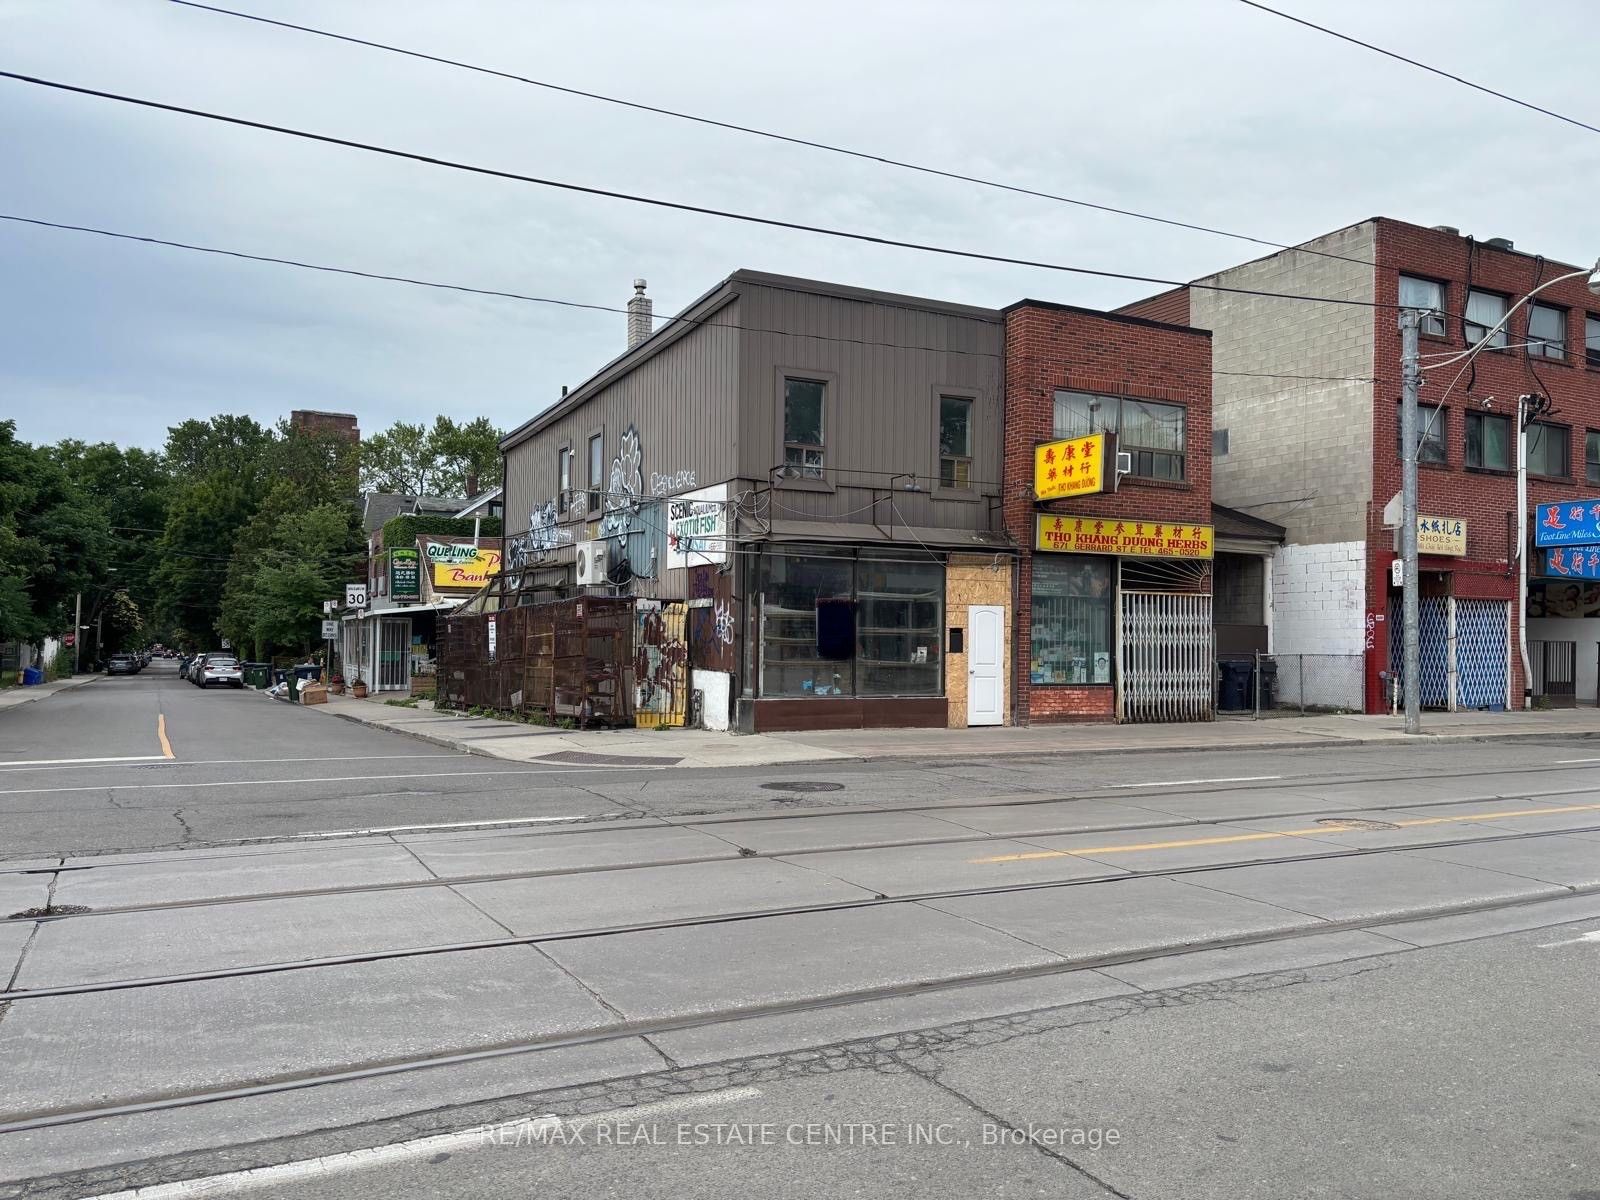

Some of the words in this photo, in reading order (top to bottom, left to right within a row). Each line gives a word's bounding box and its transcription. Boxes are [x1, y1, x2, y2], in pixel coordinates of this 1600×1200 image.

[670, 501, 693, 521] SCENIC
[676, 518, 699, 537] EXOTIC
[700, 514, 717, 534] FISH
[1045, 532, 1072, 542] THO
[1076, 534, 1118, 545] KHANG
[1122, 536, 1164, 548] DUONG
[1167, 539, 1208, 550] HERBS
[1420, 534, 1451, 544] SHOES
[451, 545, 477, 558] LING
[1074, 543, 1113, 552] GERRARD
[348, 593, 365, 605] 30
